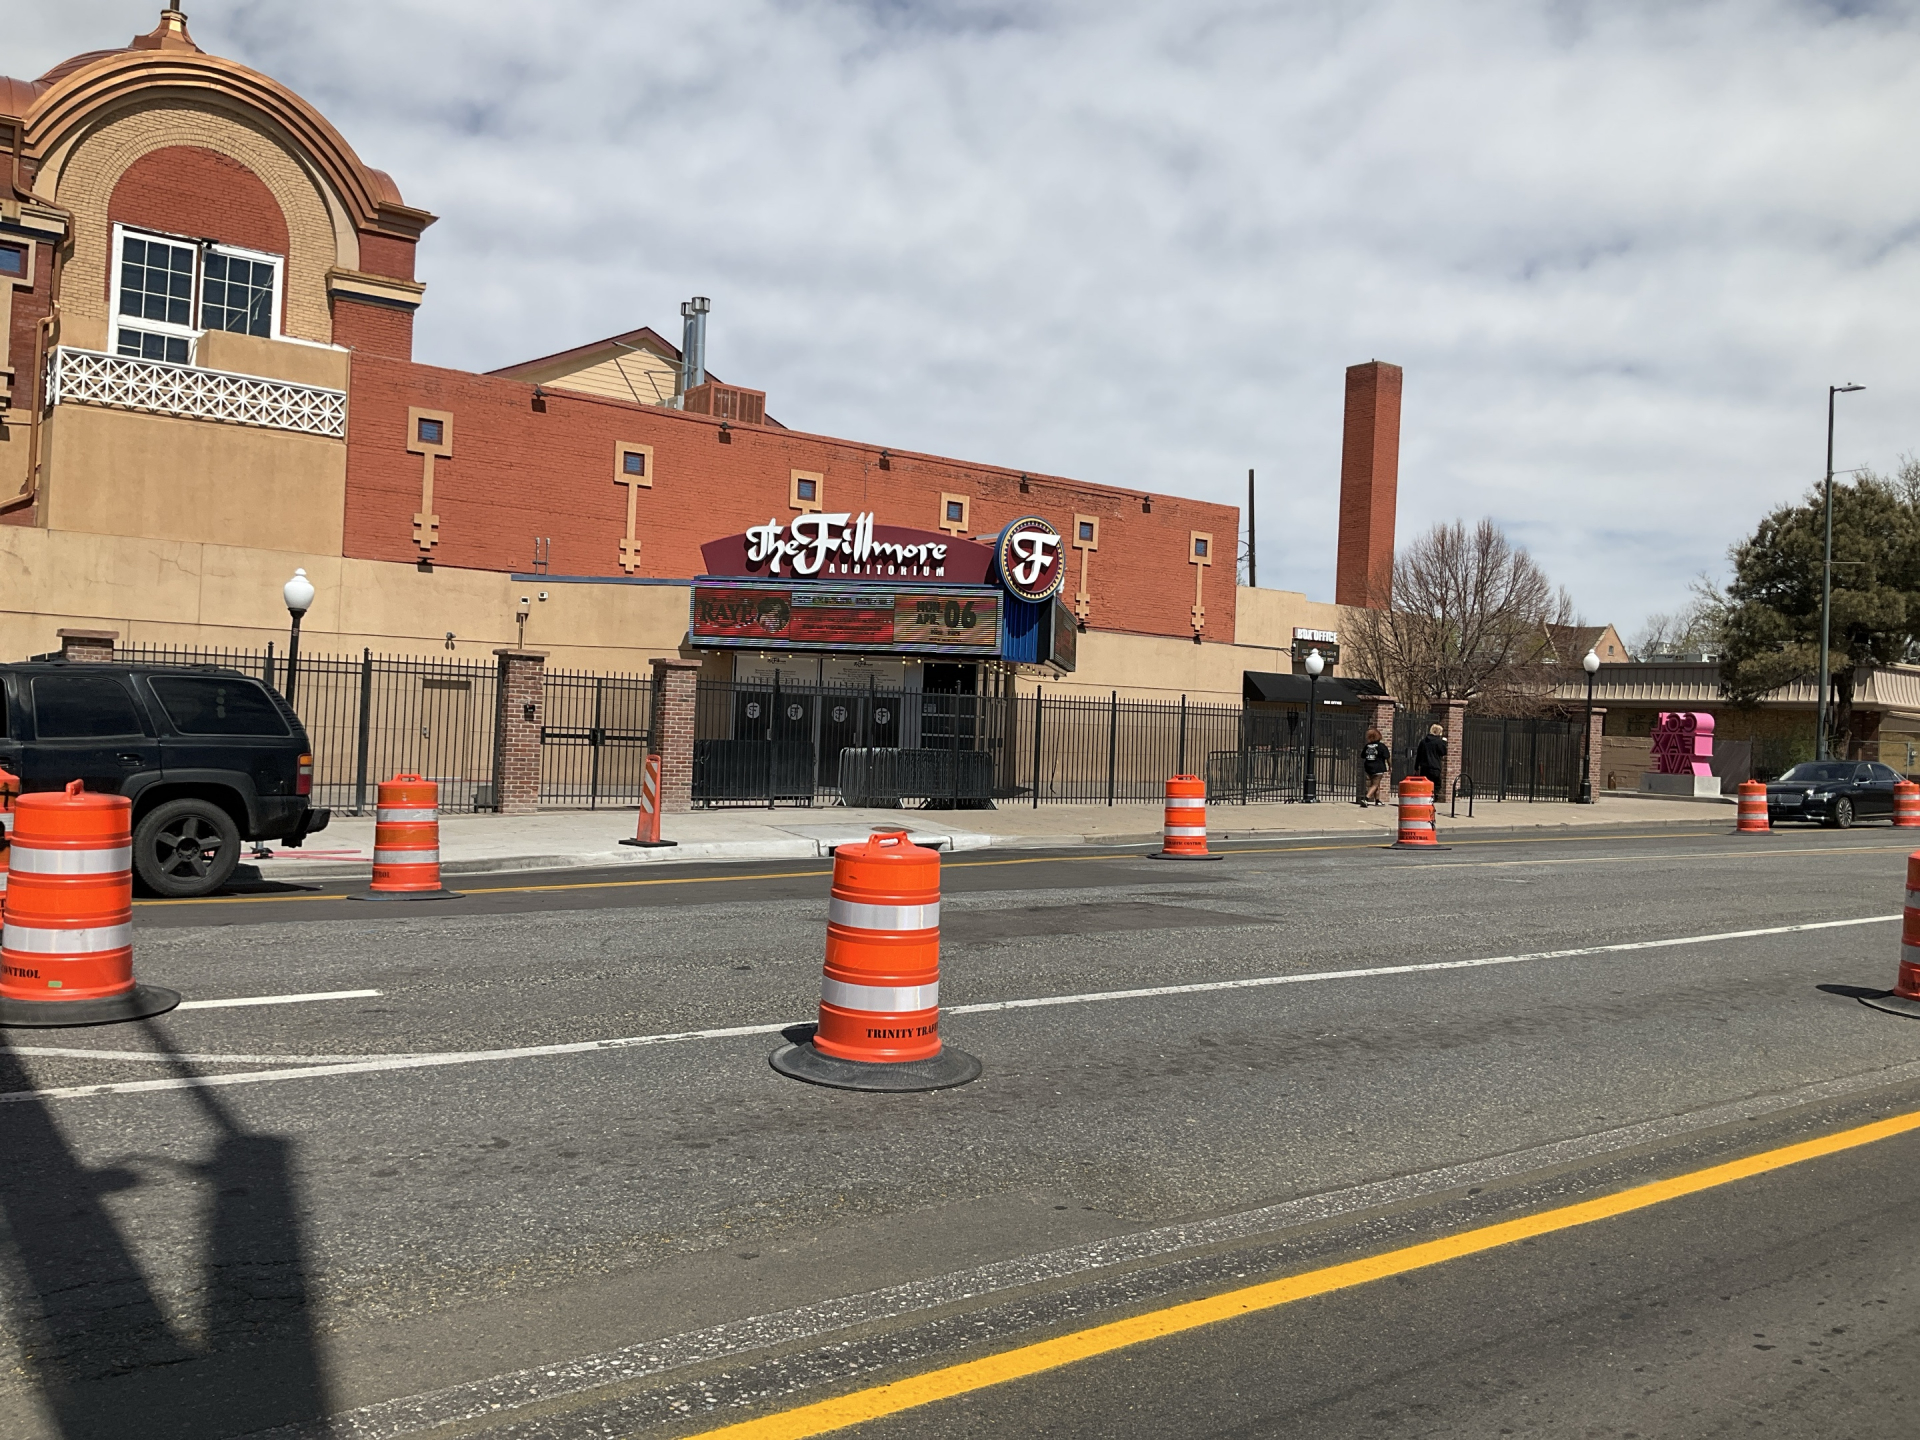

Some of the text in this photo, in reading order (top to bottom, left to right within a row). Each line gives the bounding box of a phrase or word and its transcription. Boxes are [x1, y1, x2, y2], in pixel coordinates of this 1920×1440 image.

[745, 512, 948, 575] The Fillmore
[1011, 531, 1062, 585] F
[828, 563, 945, 577] AUDITORIUM
[944, 600, 977, 628] 06
[1297, 628, 1338, 643] BOX OFFICE
[866, 1027, 914, 1039] TRINITY
